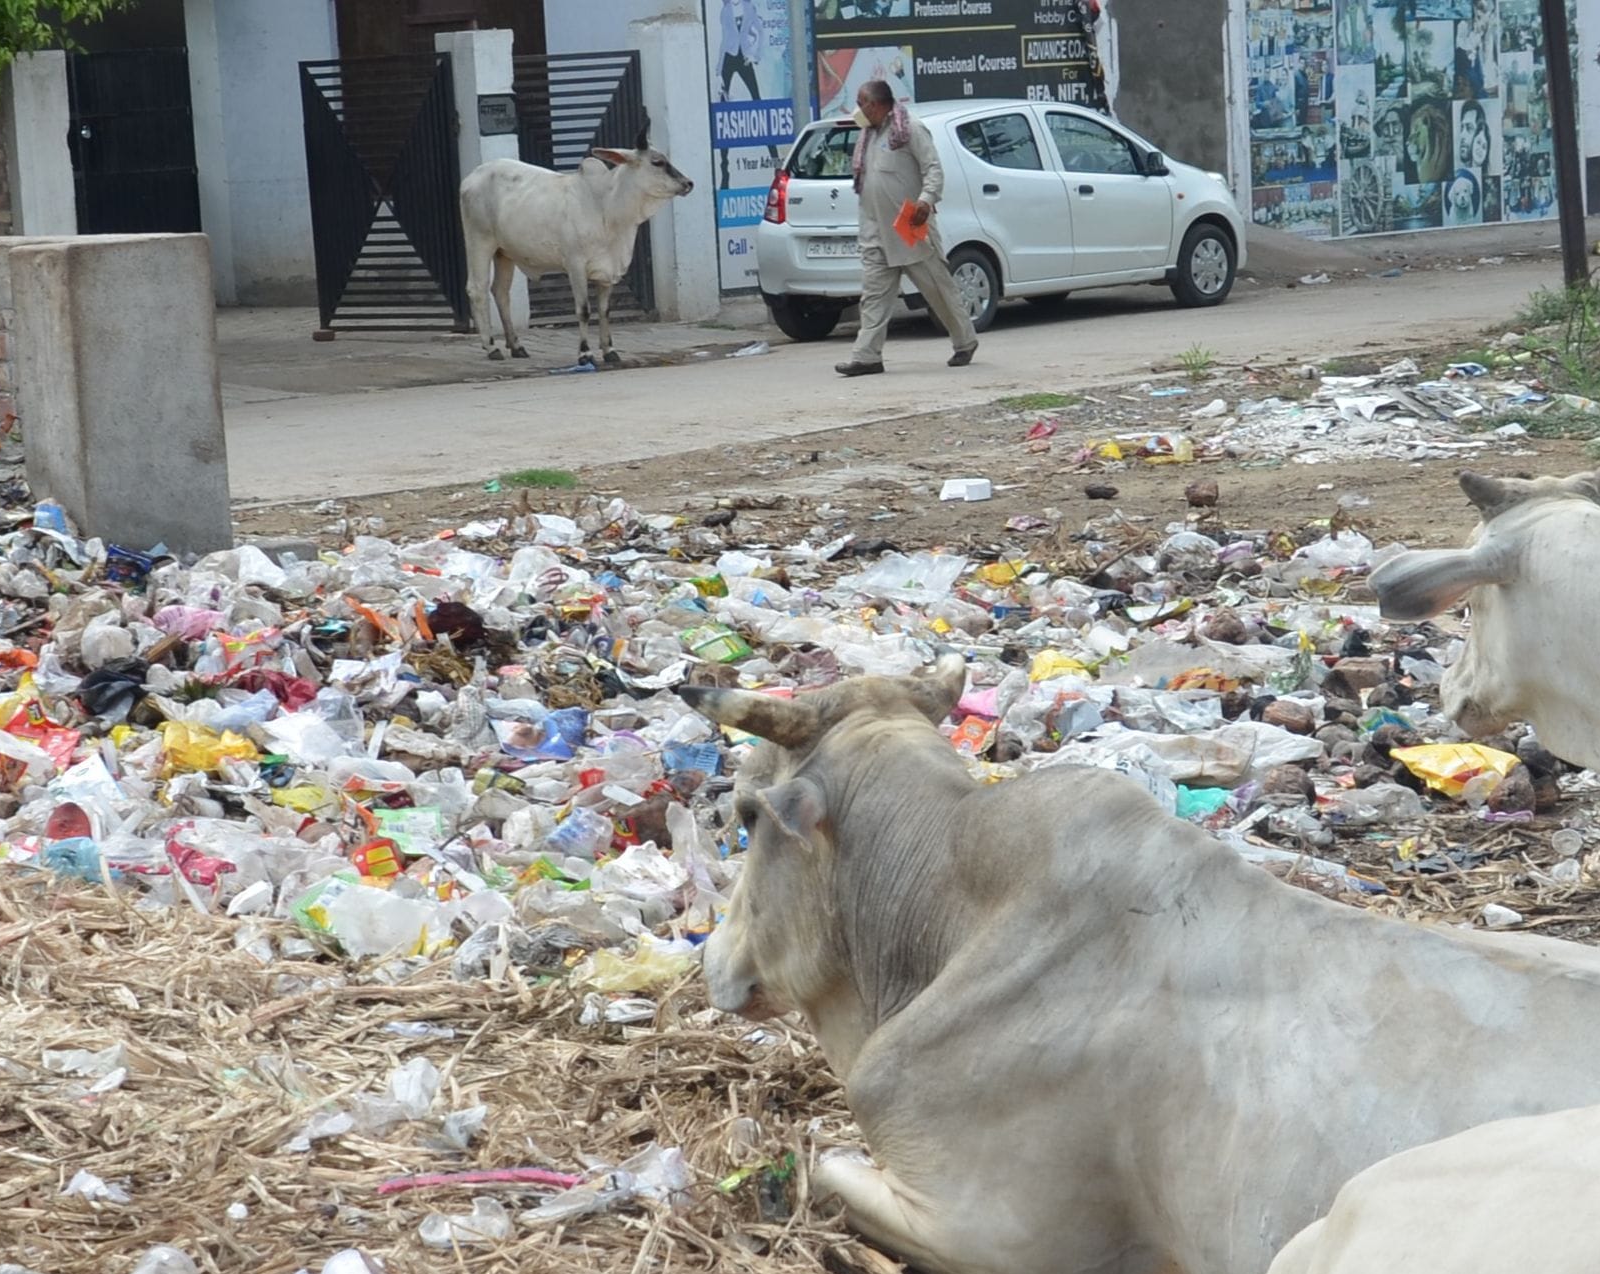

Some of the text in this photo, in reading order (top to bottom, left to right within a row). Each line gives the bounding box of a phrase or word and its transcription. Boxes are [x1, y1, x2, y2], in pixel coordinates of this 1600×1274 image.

[914, 0, 992, 17] Professional Courses
[1034, 10, 1065, 26] Hobby
[1027, 40, 1067, 60] ADVANCE
[917, 54, 1017, 75] Professional Courses
[1062, 68, 1078, 80] For
[963, 78, 973, 95] in
[716, 109, 767, 139] FASHION
[770, 107, 794, 136] DES
[722, 193, 768, 219] ADMISS
[728, 238, 748, 255] Call
